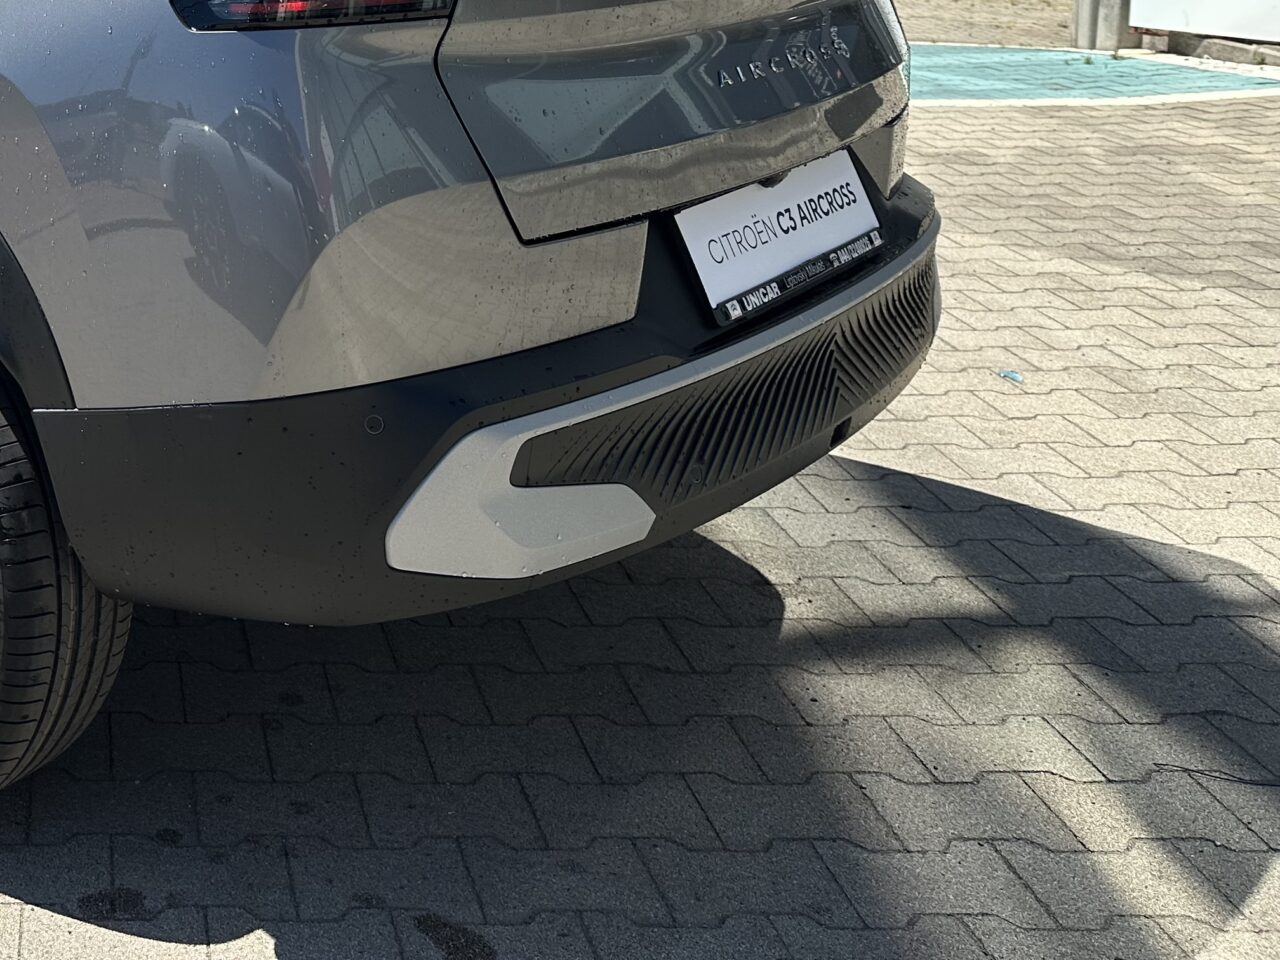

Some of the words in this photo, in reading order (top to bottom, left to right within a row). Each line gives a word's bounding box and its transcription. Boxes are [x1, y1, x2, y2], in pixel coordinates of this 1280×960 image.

[708, 213, 778, 264] CITROËN
[776, 207, 797, 235] C3
[797, 182, 857, 227] AIRCROSS
[742, 282, 781, 311] UNICAR
